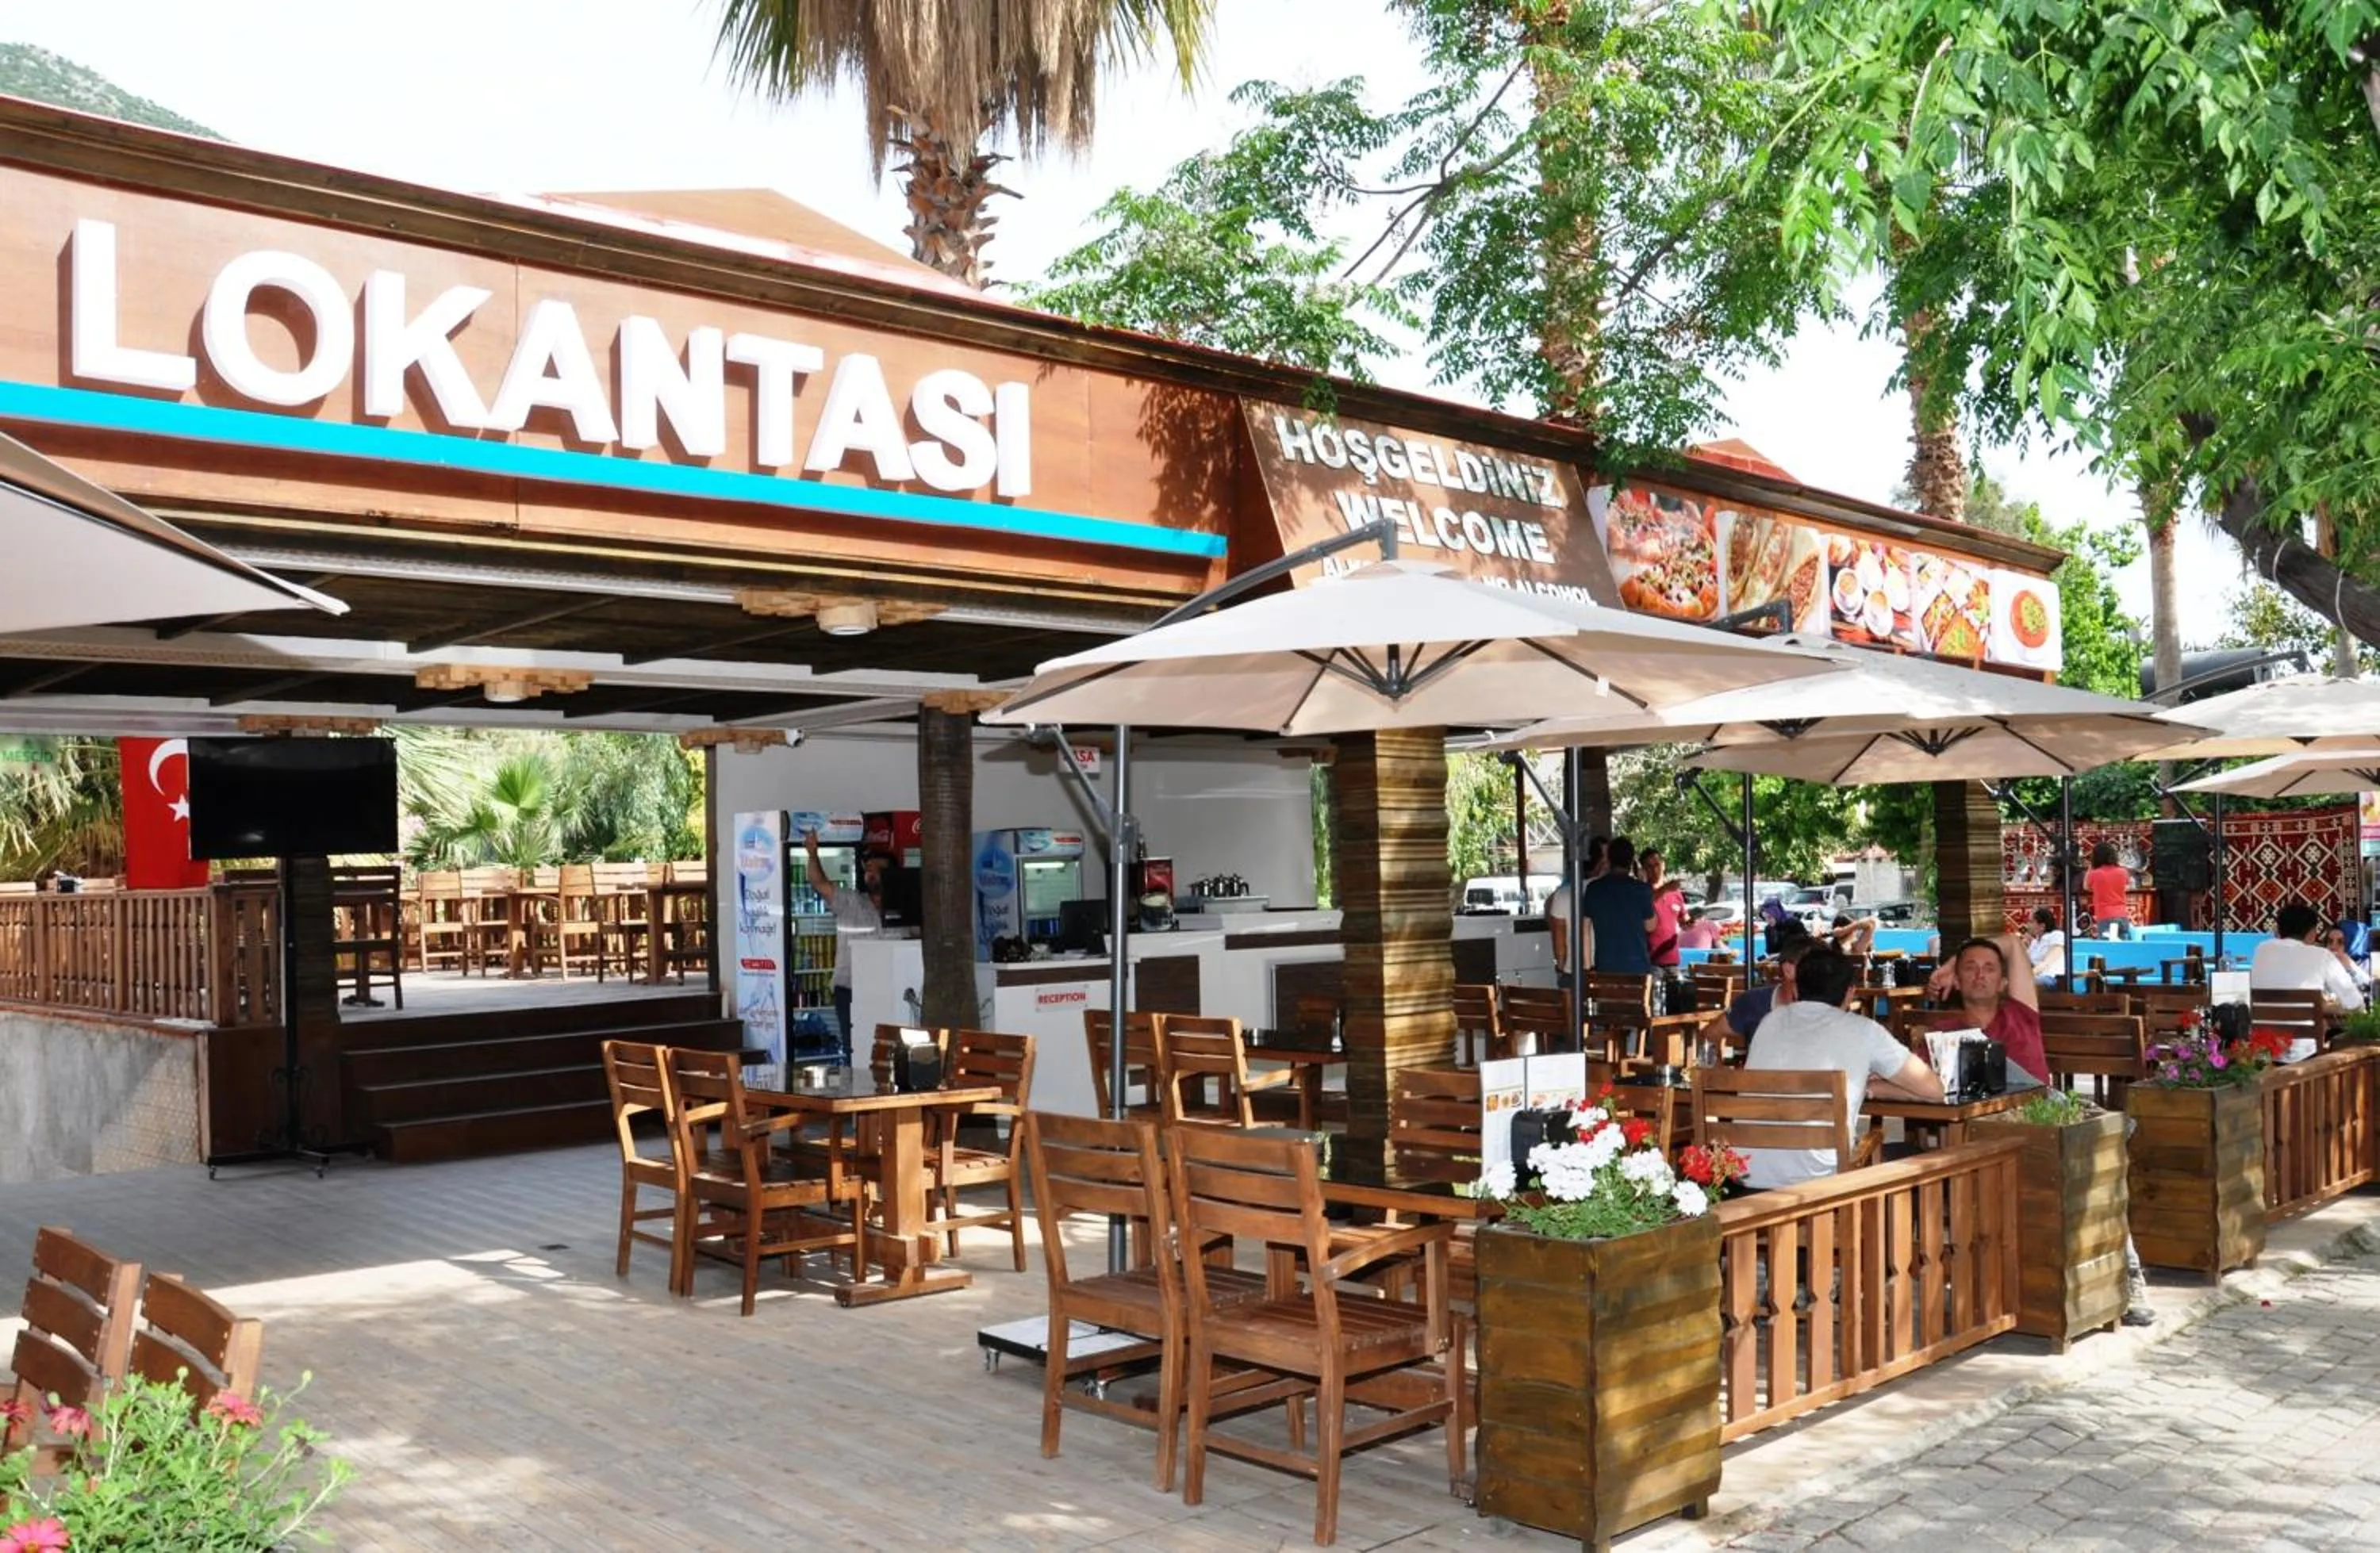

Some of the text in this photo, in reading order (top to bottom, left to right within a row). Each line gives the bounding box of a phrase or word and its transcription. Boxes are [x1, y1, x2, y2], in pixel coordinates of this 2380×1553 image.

[72, 218, 1031, 497] LOKANTASI
[1334, 489, 1557, 564] WELCOME
[1038, 991, 1086, 1004] RECEPTION
